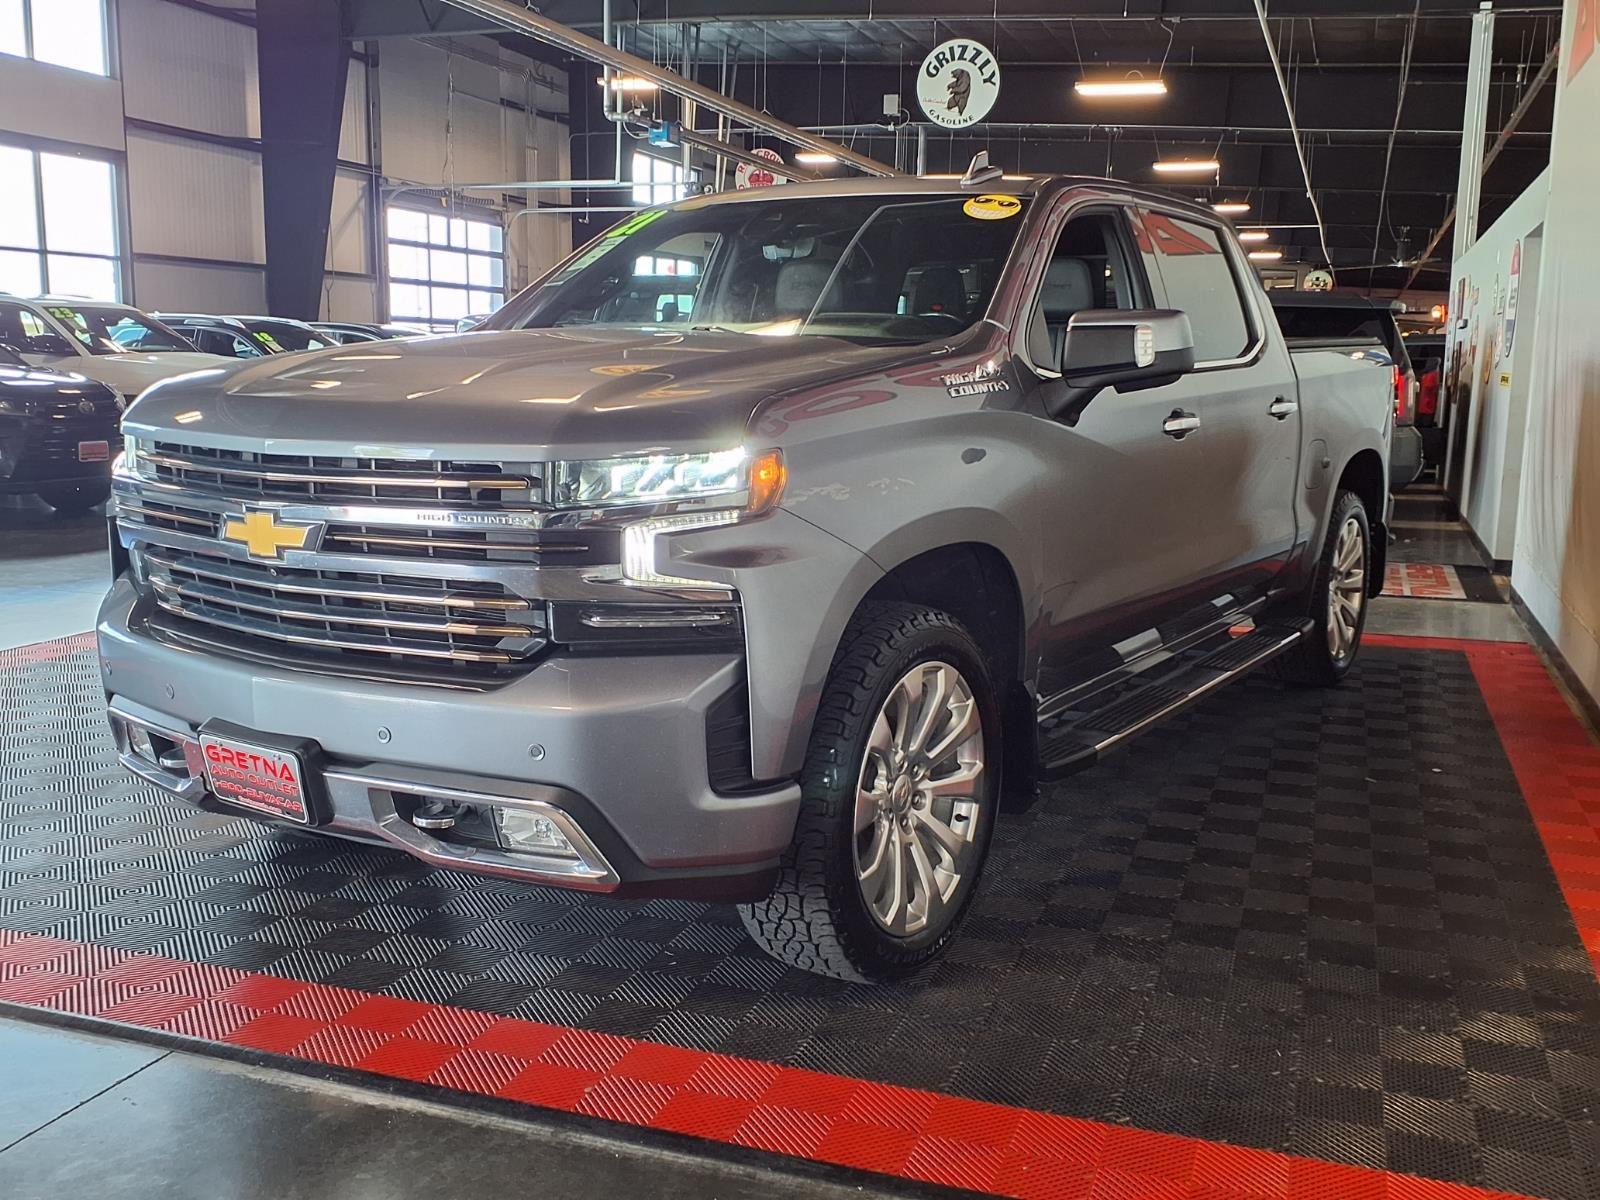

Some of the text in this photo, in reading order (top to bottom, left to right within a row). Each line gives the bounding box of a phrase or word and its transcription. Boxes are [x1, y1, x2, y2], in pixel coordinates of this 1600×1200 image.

[925, 44, 996, 86] GRIZZLY
[929, 109, 974, 126] GASOLINE
[948, 381, 1010, 398] COUNTRY
[205, 744, 295, 783] GRETNA
[211, 765, 299, 798] AUTO OUTLET
